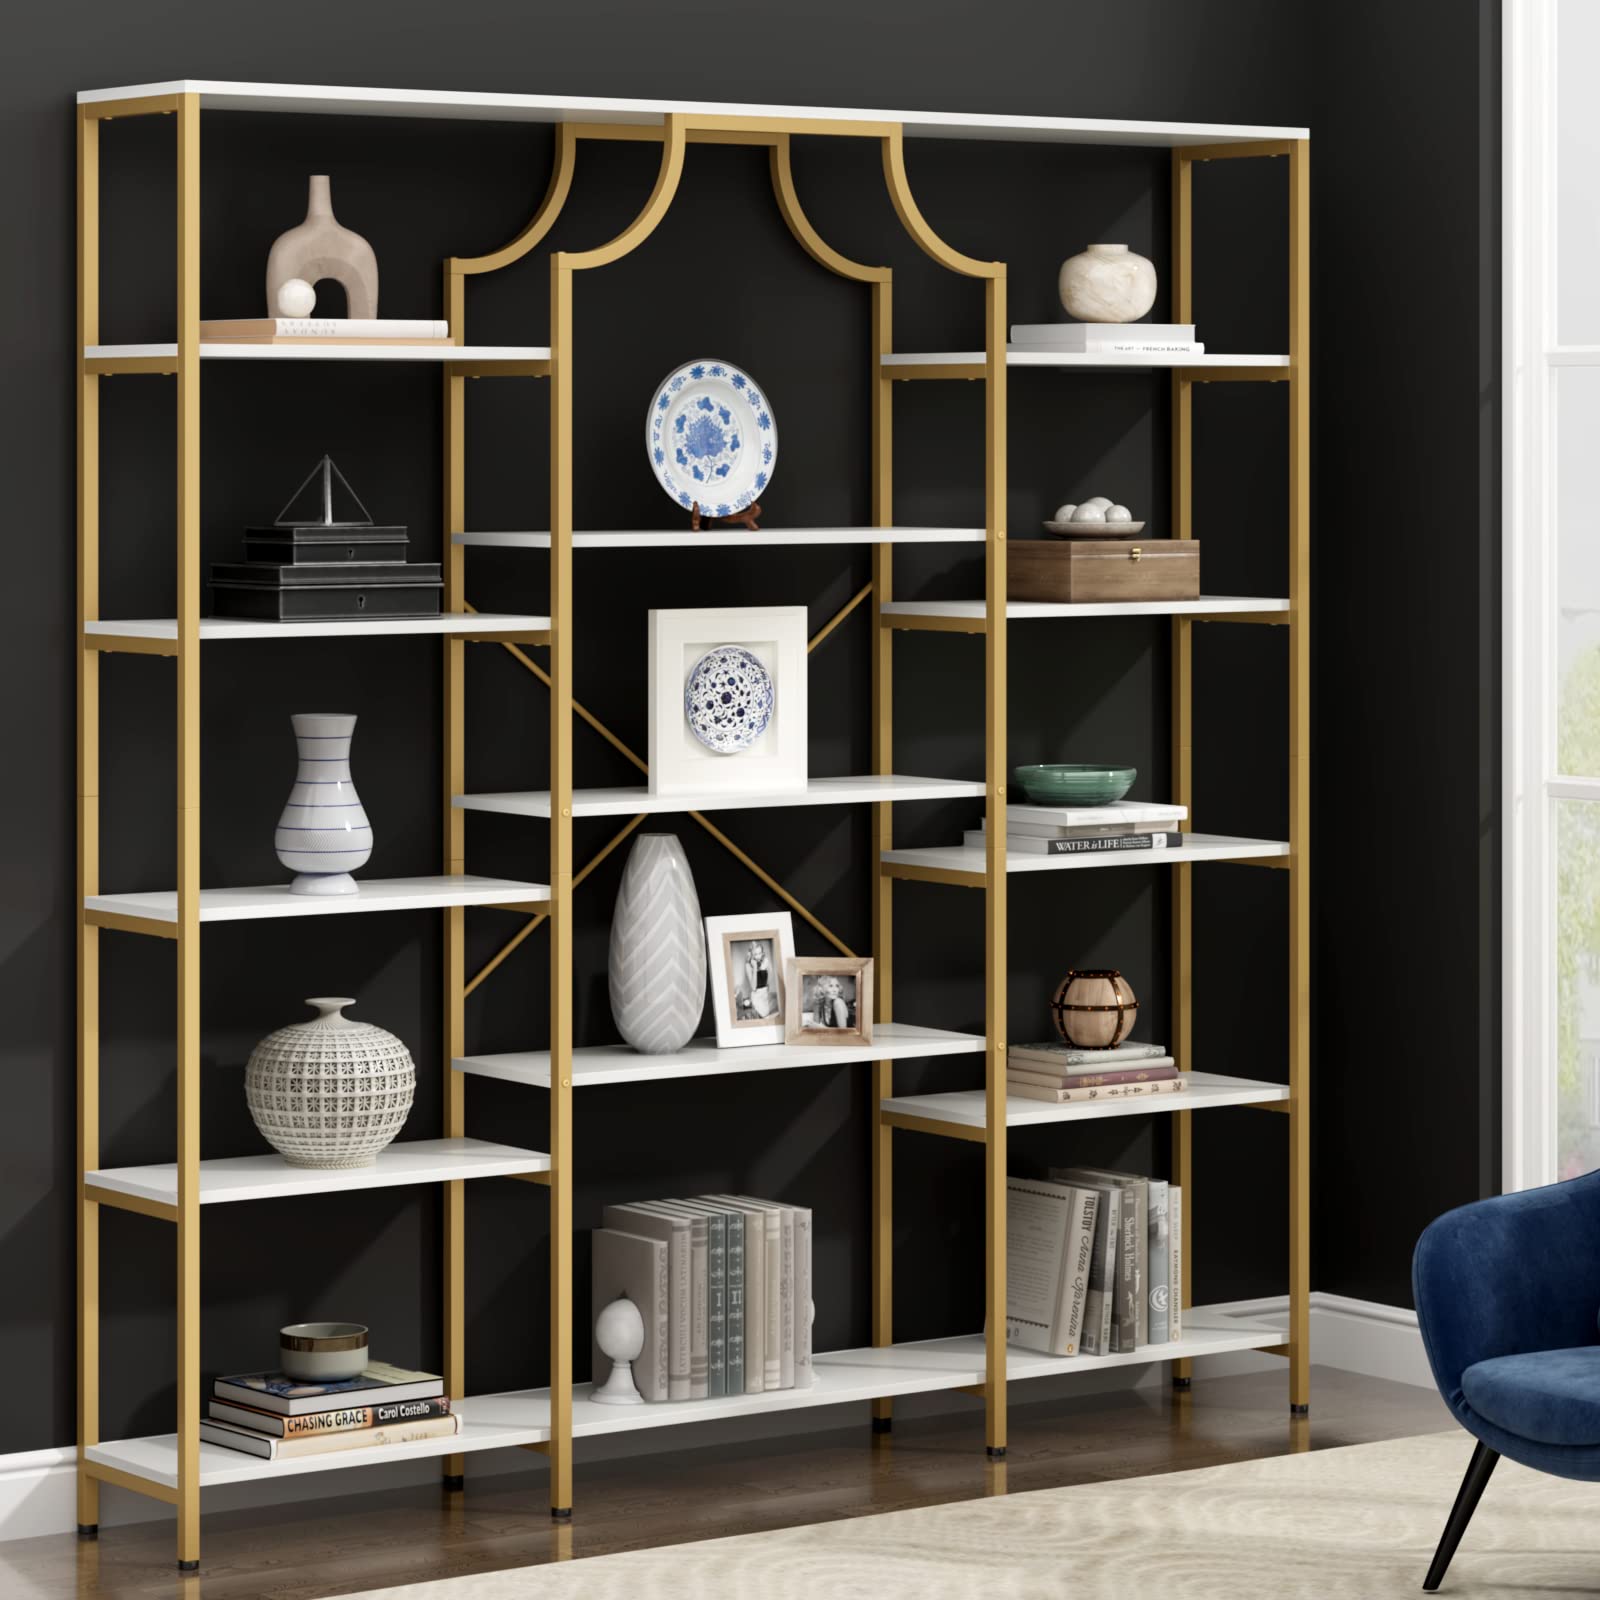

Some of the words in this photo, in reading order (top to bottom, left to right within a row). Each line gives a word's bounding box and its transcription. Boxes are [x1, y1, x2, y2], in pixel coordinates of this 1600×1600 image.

[1055, 841, 1090, 852] WATER
[1091, 840, 1098, 849] is
[1098, 838, 1120, 849] LIFE
[1082, 1196, 1096, 1232] TOLSTOY
[1125, 1217, 1135, 1251] Sherlock
[1076, 1235, 1091, 1273] Anna
[1124, 1252, 1135, 1281] Holmes
[731, 1289, 742, 1305] II
[1068, 1276, 1085, 1338] Karenina
[287, 1413, 333, 1433] CHASING
[335, 1409, 368, 1427] GRACE
[378, 1406, 399, 1421] Carol
[400, 1402, 430, 1417] Costello
